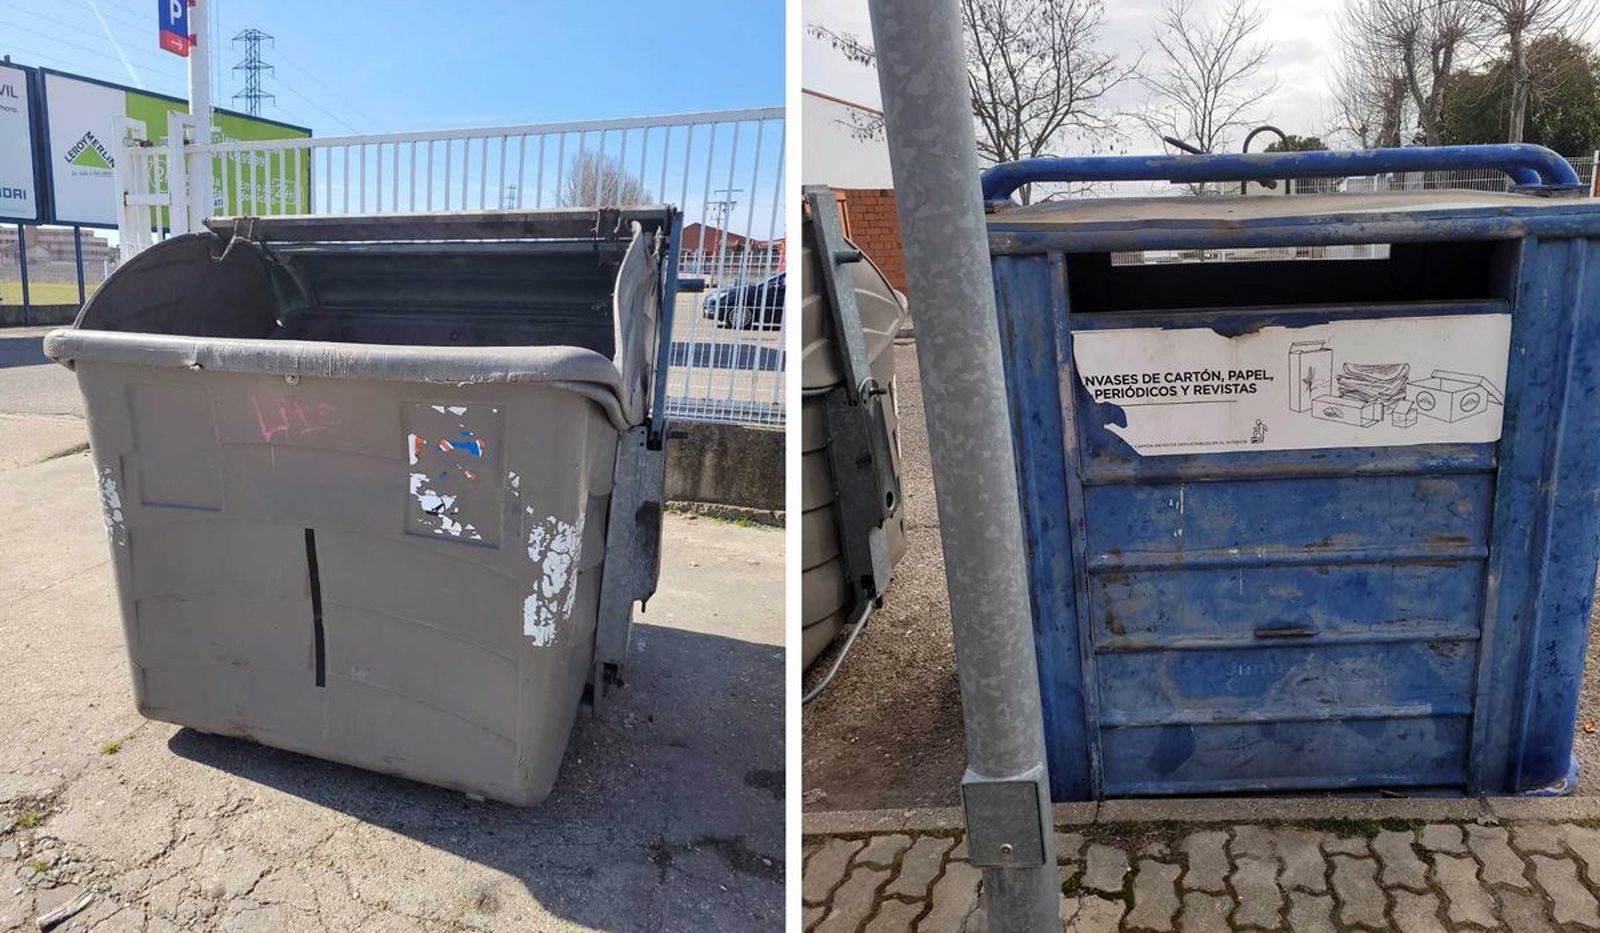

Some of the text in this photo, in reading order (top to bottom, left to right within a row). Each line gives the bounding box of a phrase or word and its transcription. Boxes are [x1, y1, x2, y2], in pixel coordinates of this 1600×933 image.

[64, 131, 115, 168] LEROY MERLIN
[0, 187, 26, 201] DRI
[1083, 369, 1274, 386] NVASES DE CARTÓN, PAPEL,
[1095, 383, 1257, 399] PERIÓDICOS Y REVISTAS
